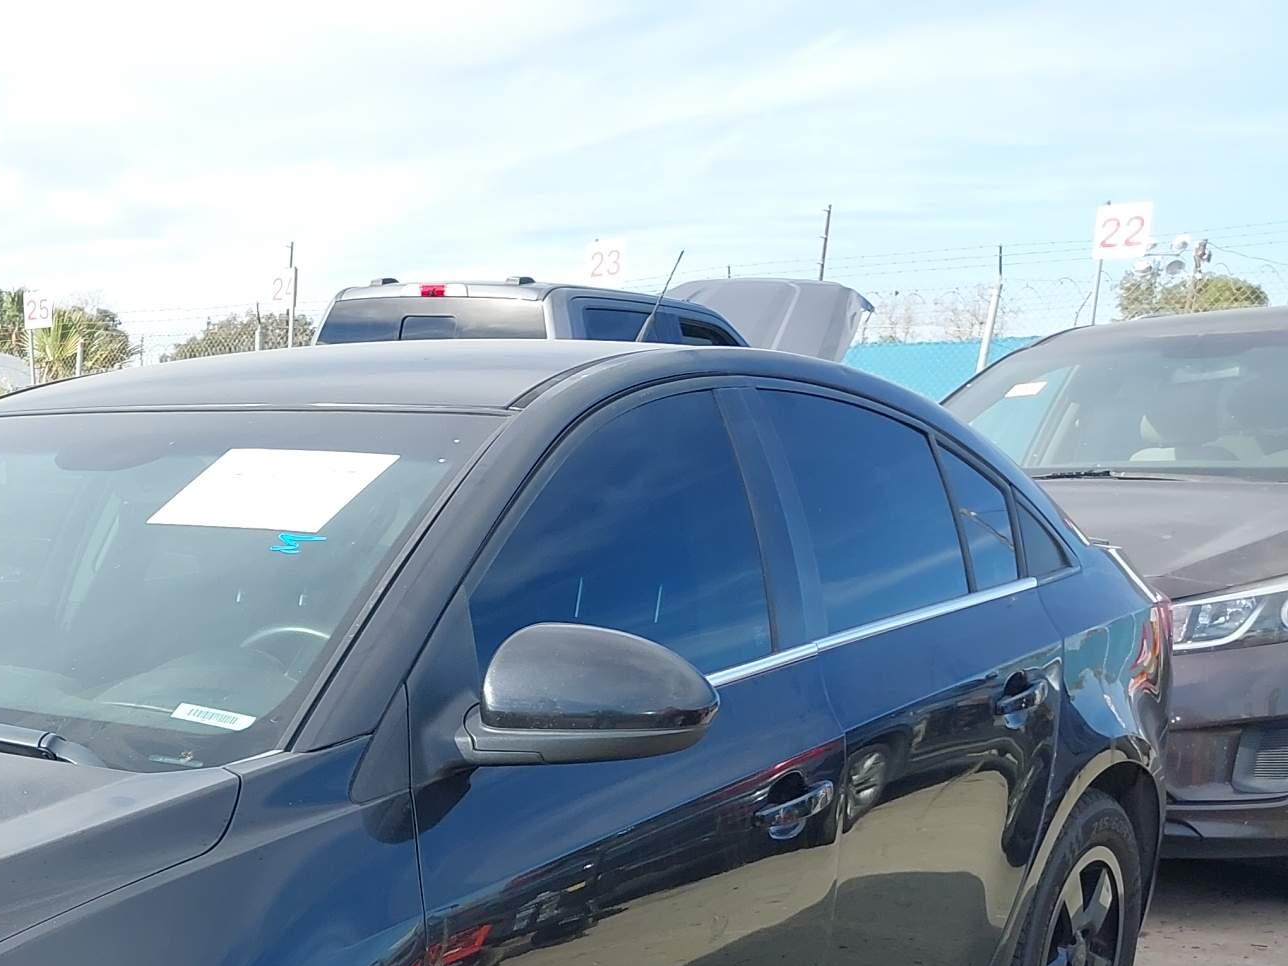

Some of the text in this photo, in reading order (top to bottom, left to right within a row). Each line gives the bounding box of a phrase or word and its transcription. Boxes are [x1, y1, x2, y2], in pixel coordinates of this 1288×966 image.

[1099, 216, 1145, 248] 22
[591, 249, 621, 277] 23
[26, 298, 49, 320] 25
